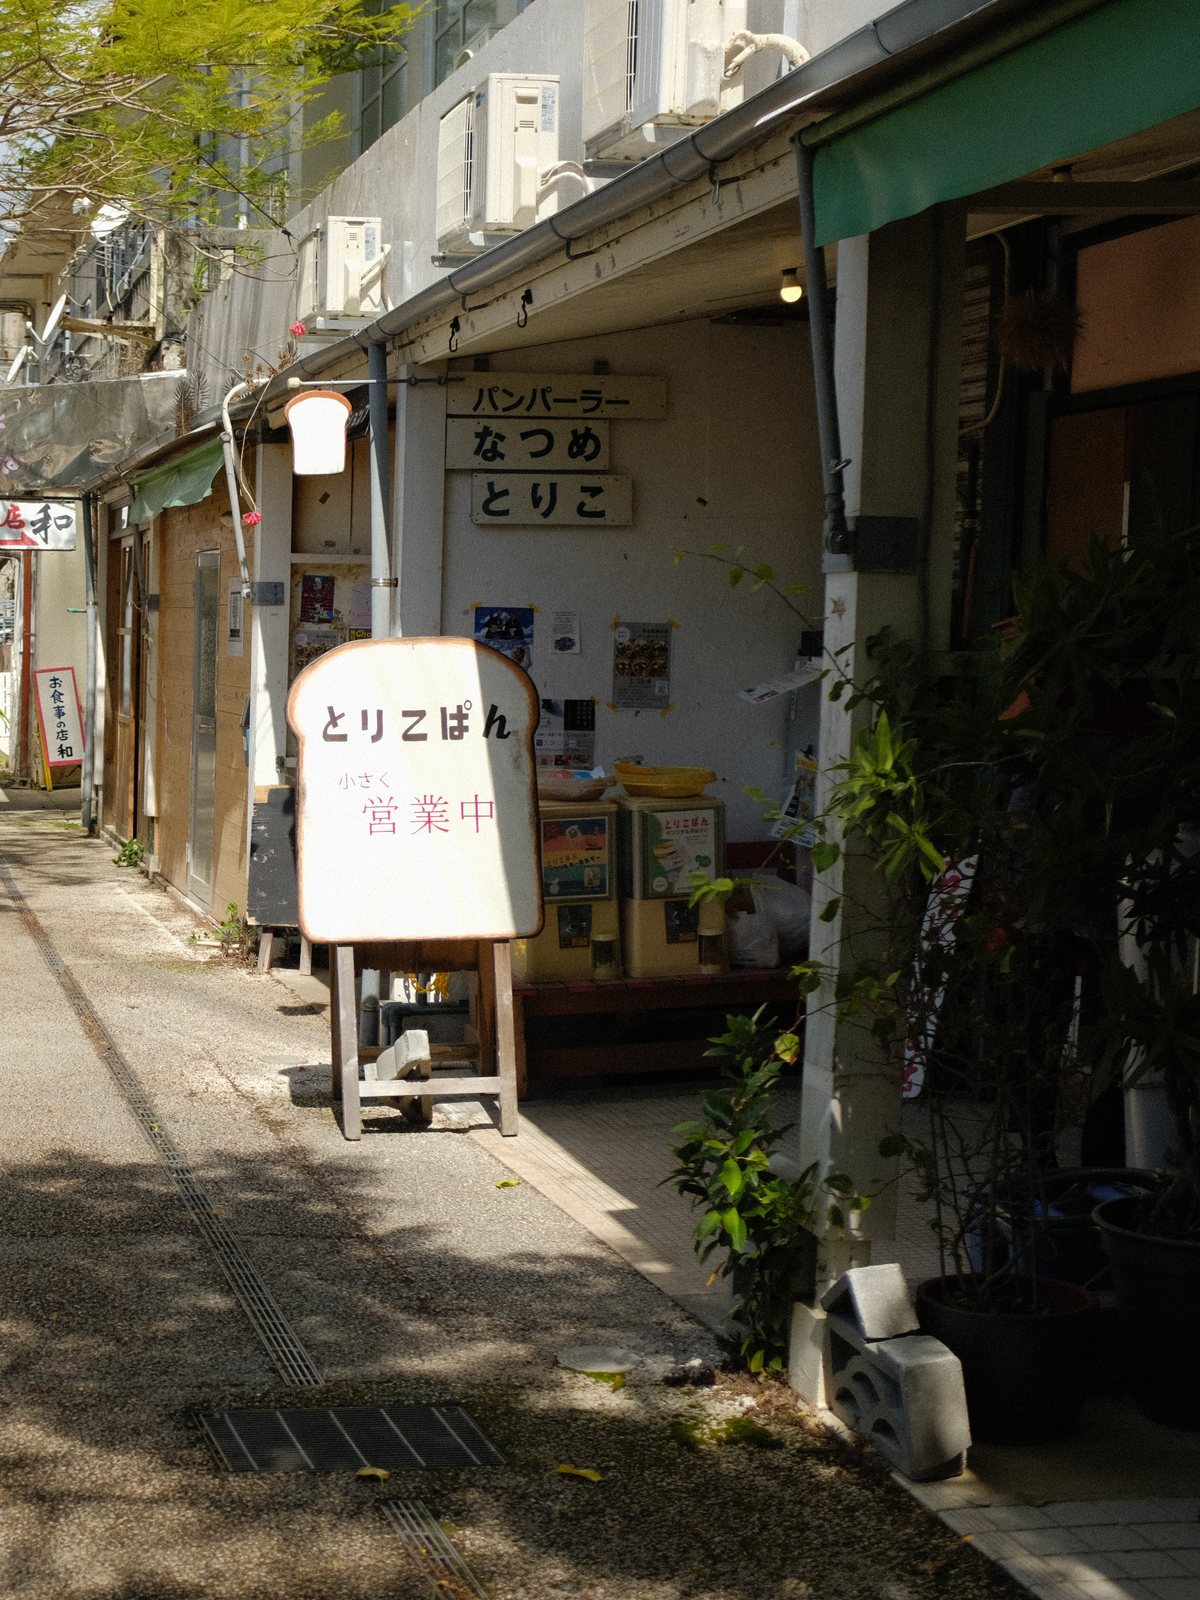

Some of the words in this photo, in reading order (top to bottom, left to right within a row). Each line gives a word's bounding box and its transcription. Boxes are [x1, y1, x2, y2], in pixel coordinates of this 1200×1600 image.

[472, 385, 630, 413] パンパーラー
[473, 425, 602, 462] なつめ
[481, 481, 606, 519] とりこ
[321, 699, 511, 744] とりこぱん
[338, 772, 391, 790] 小さく
[362, 794, 496, 836] 営業中
